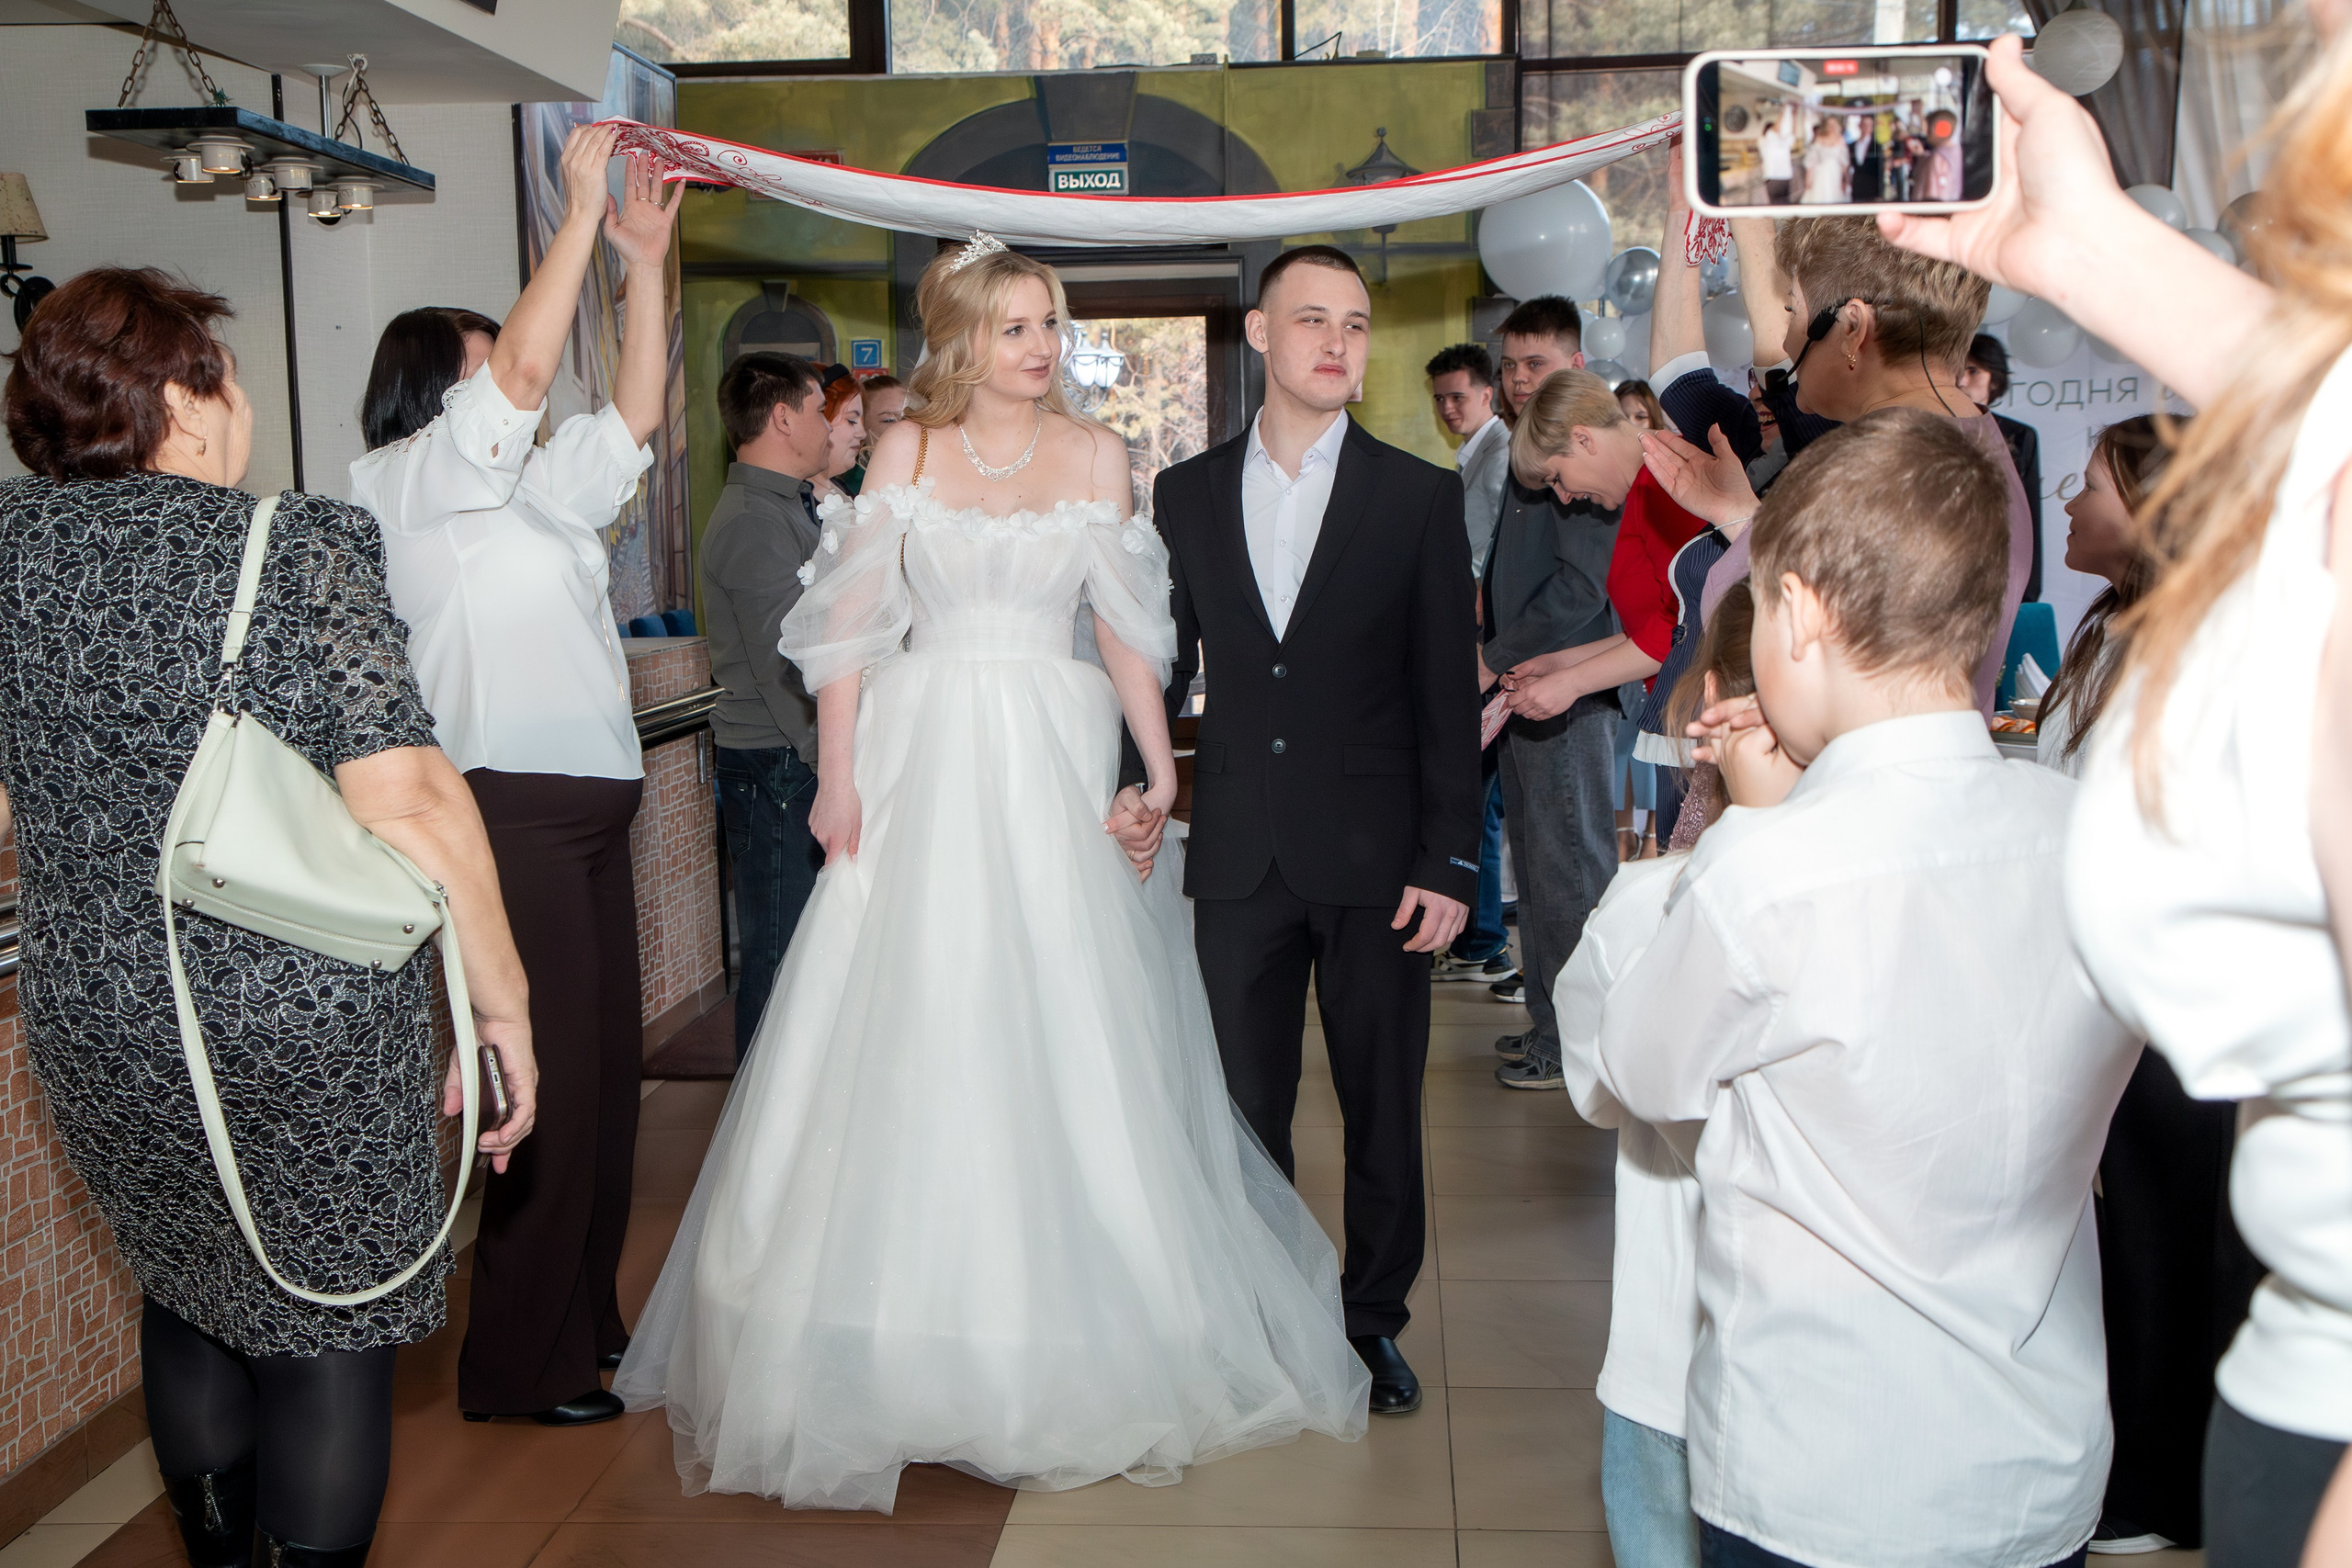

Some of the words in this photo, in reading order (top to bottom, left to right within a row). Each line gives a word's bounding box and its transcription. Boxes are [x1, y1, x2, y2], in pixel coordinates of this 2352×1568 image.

[1072, 145, 1102, 153] ВЕДЕТСЯ
[1055, 152, 1120, 162] ВИДЕОНАБЛЮДЕНИЕ
[1057, 173, 1121, 189] ВЫХОД
[861, 346, 873, 363] 7
